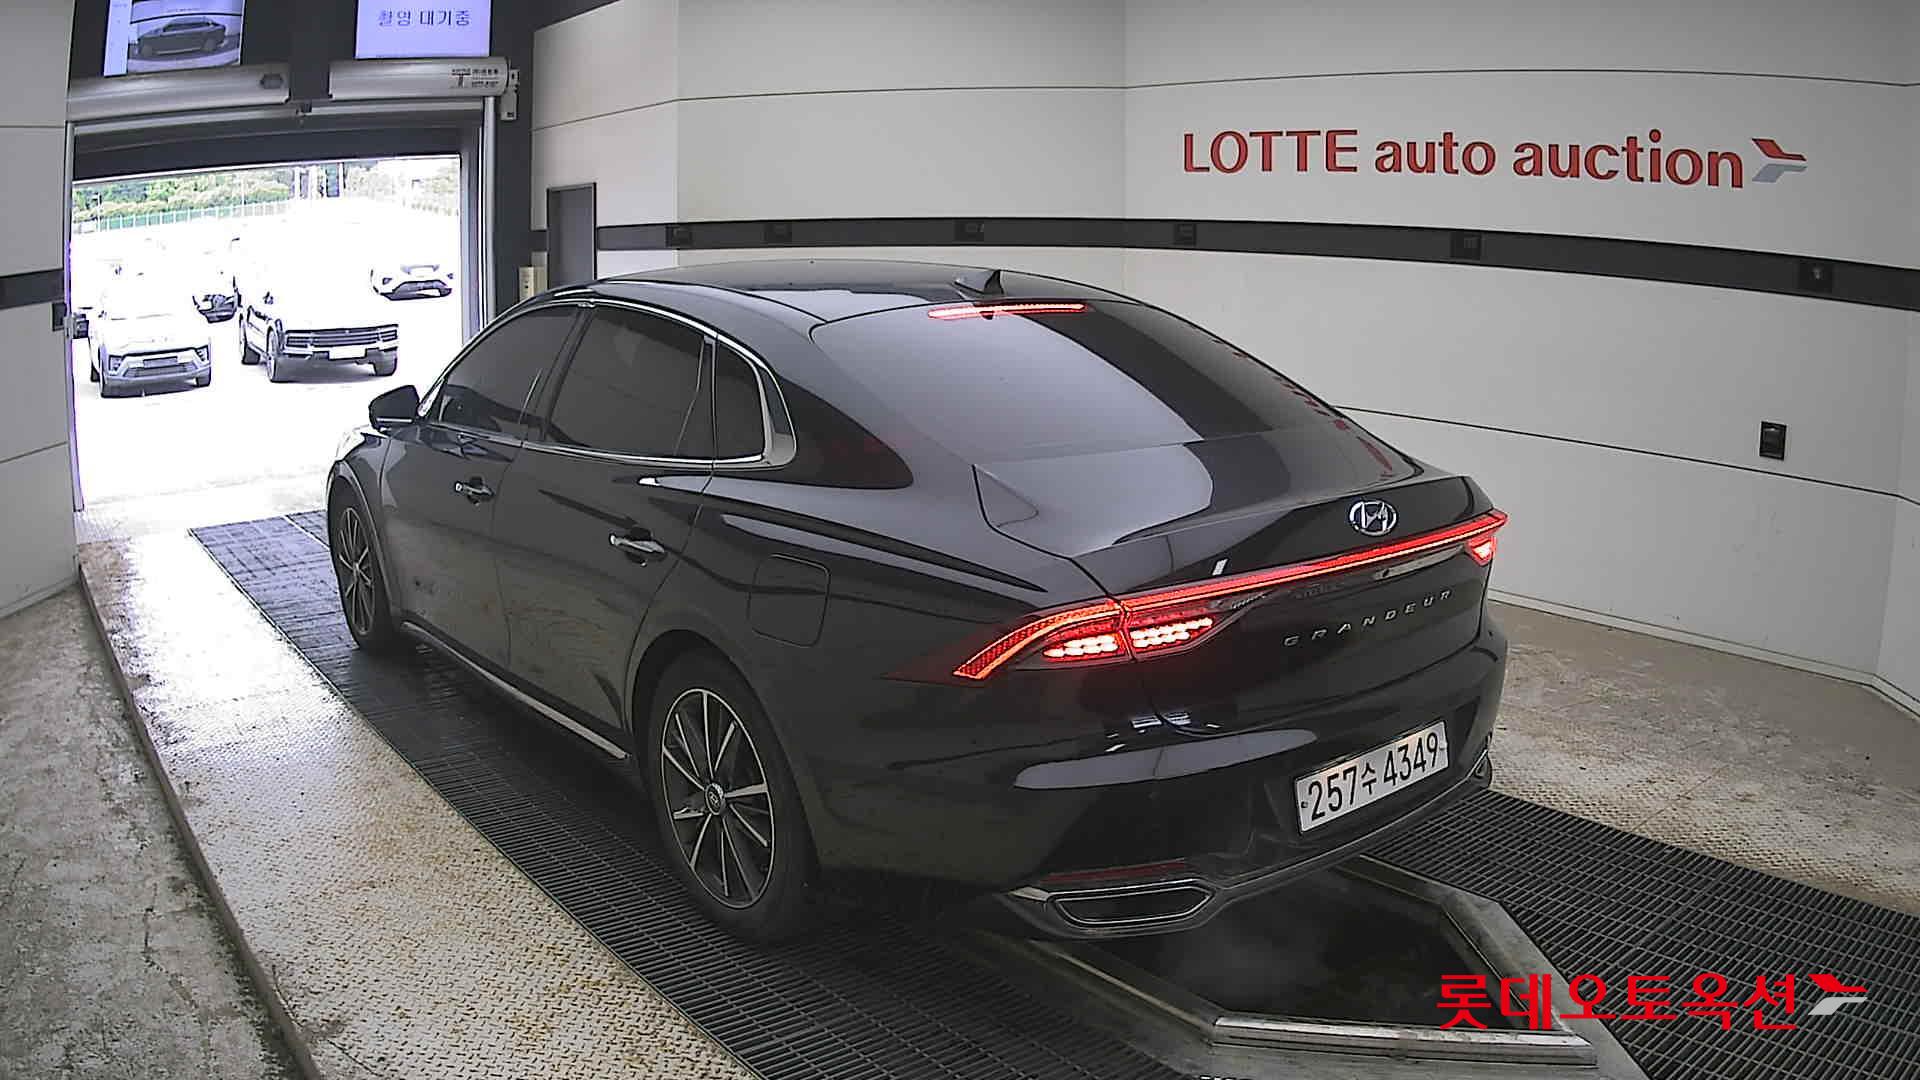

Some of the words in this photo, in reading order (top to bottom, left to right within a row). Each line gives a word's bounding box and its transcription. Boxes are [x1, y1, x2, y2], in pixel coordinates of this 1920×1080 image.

[419, 9, 470, 26] 대기중
[1184, 129, 1358, 174] LOTTE
[1375, 131, 1496, 176] auto
[1512, 128, 1743, 188] auction
[1284, 590, 1451, 647] GRANDEUR
